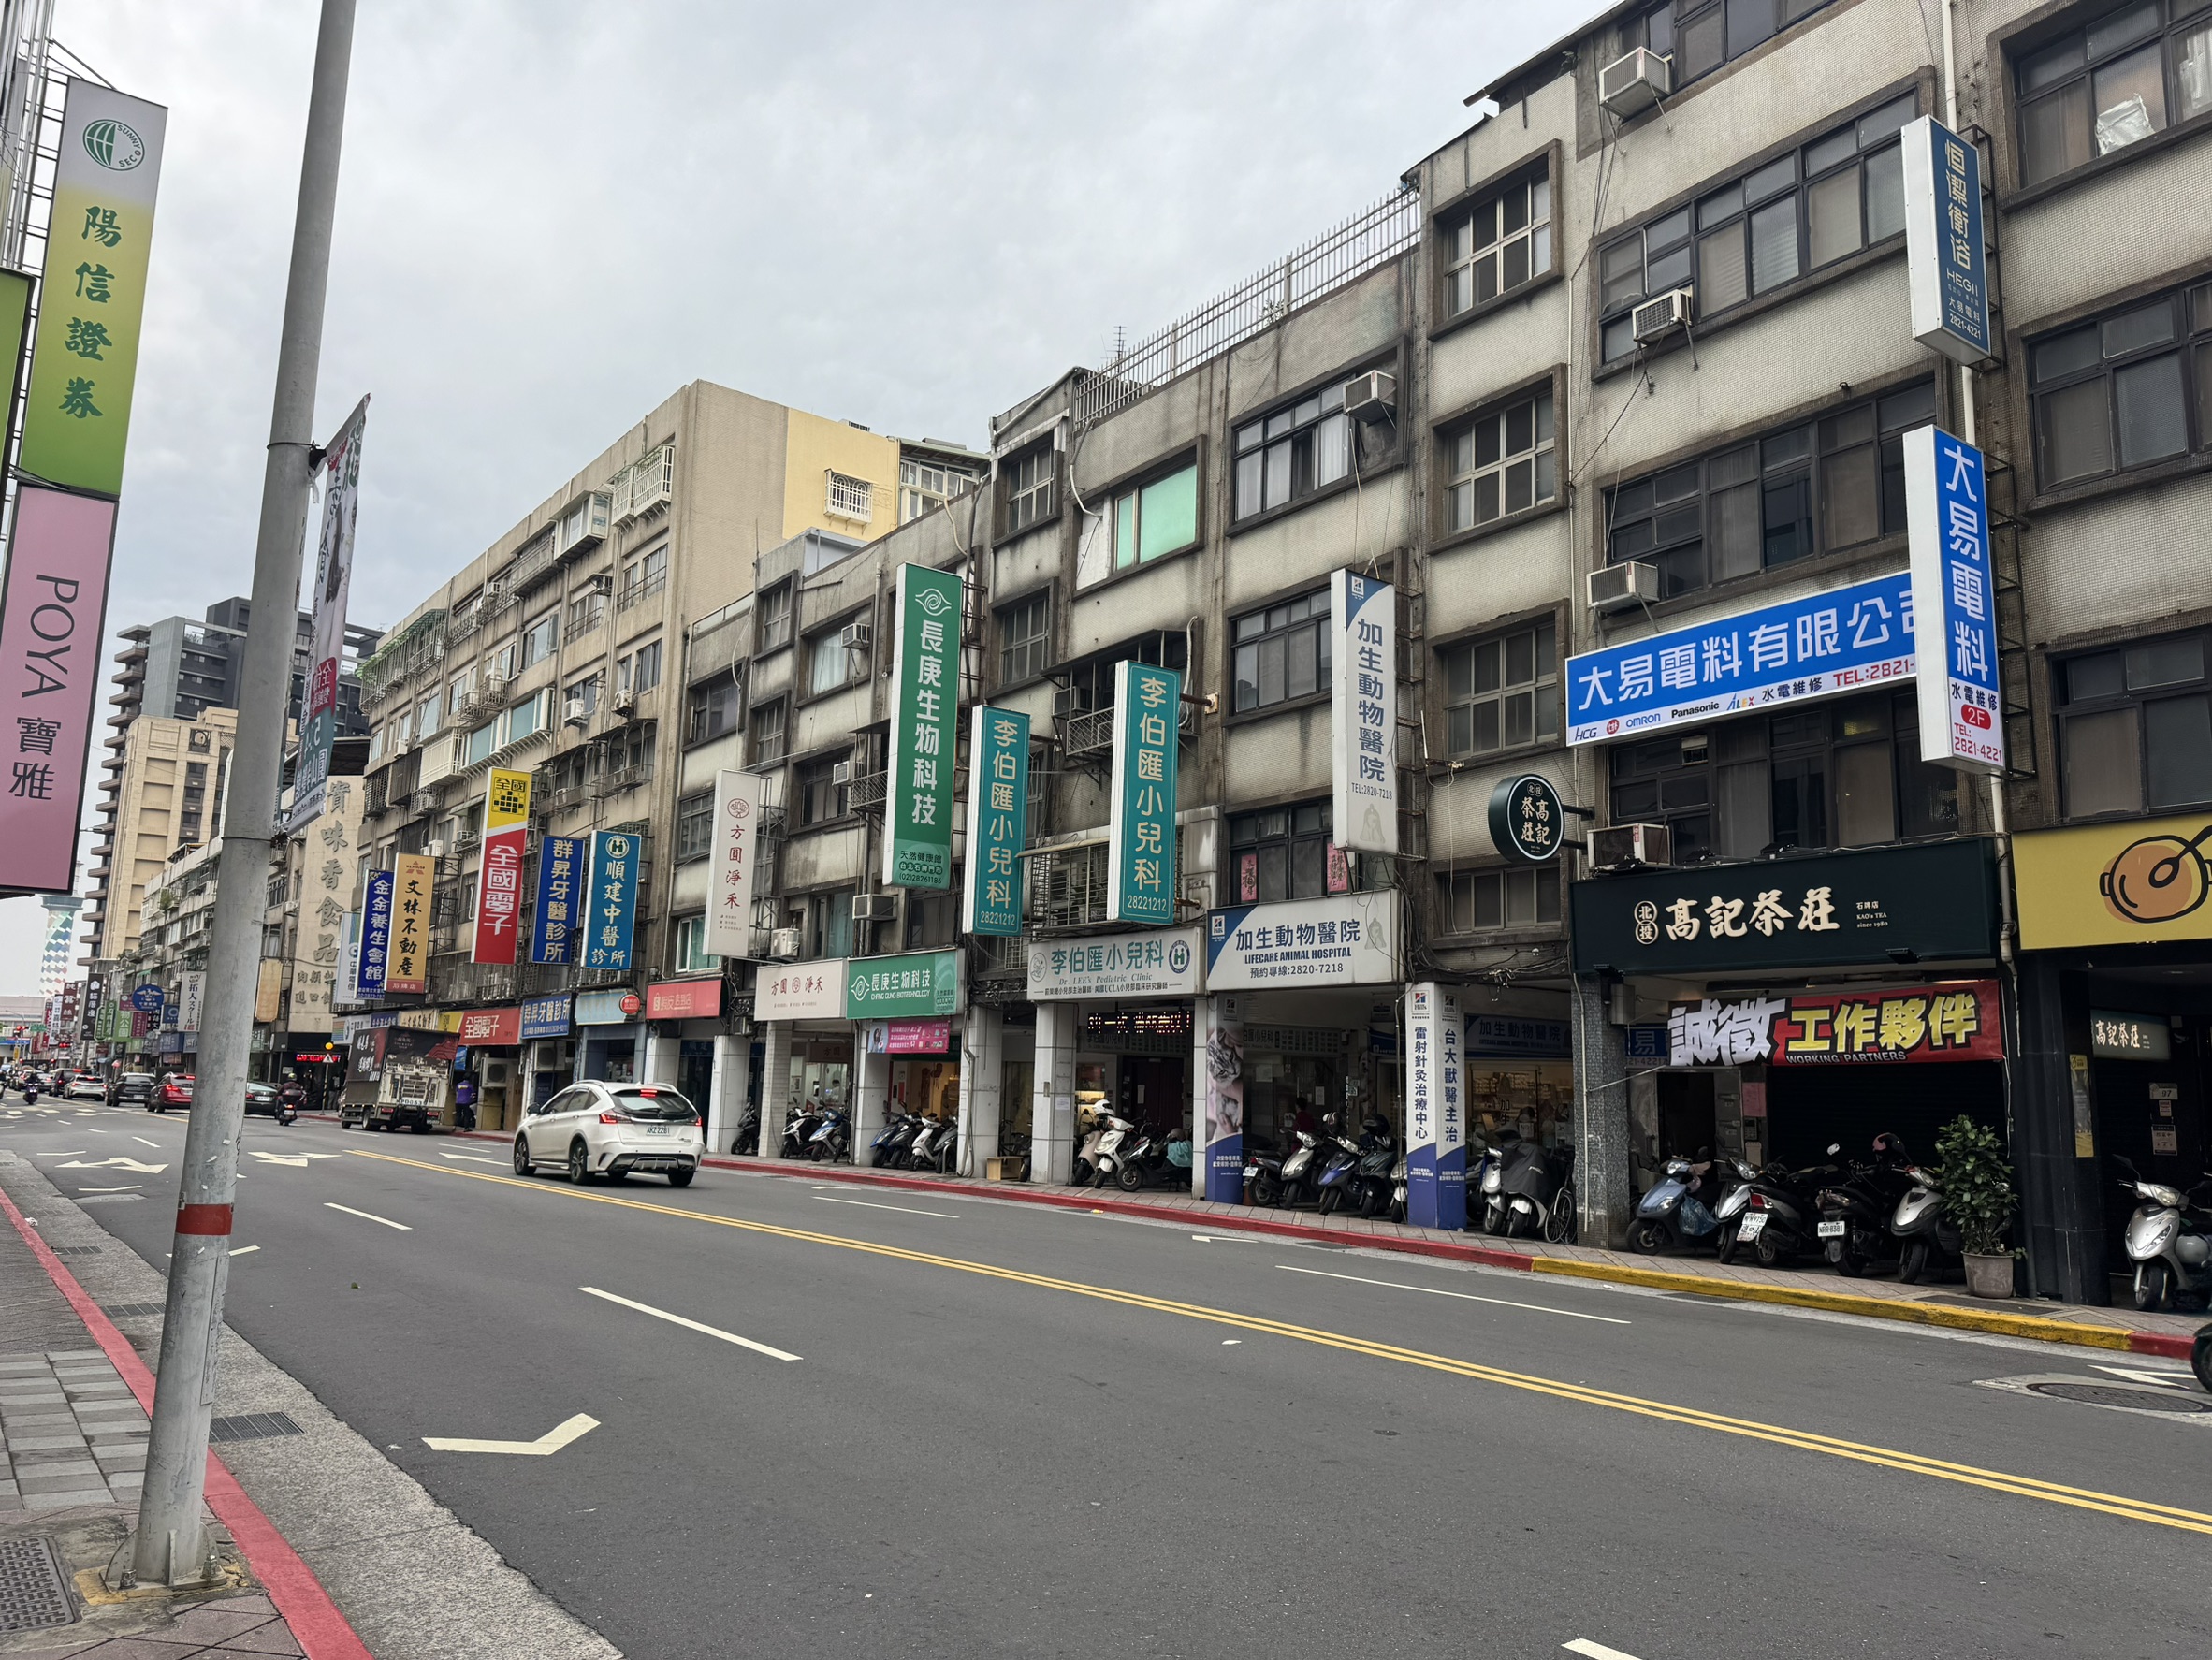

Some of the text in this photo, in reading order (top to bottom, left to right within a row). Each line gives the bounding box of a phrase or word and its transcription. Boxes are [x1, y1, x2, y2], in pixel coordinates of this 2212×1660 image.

[117, 124, 141, 149] SUNNY
[1946, 267, 1978, 298] HEGII
[58, 205, 123, 420] 陽信證券
[1948, 296, 1980, 324] 大易電料
[1949, 313, 1982, 340] 2821-4221
[1943, 444, 1988, 683] 大易電料
[8, 574, 80, 801] POYA 寶雅
[1358, 618, 1386, 783] 加生動物醫院
[1951, 681, 1999, 712] 水電維修
[911, 619, 944, 826] 長庚生物科技
[1574, 726, 1597, 743] HCG
[1625, 712, 1661, 729] OMRON
[1670, 701, 1720, 720] Panasonic
[1726, 693, 1755, 711] ALEX
[1761, 677, 1823, 703] 水電維修
[1967, 707, 1985, 726] 2F
[1954, 722, 1972, 739] TEL:
[1954, 737, 2003, 764] 2821-4221
[494, 778, 526, 793] 全國
[1134, 676, 1167, 893] 李伯匯小兒科
[1351, 782, 1393, 801] TEL:2820-7218
[985, 719, 1018, 909] 李伯匯小兒科
[723, 824, 746, 910] 方圓淨禾
[900, 850, 942, 864] 天然健康館
[483, 844, 518, 936] 全國電子
[899, 872, 942, 884] (02)28261186
[543, 839, 574, 962] 群昇牙醫診所
[601, 859, 627, 948] 順建中醫
[1128, 895, 1167, 912] 28221212
[1855, 901, 1880, 910] 石牌店
[365, 879, 392, 981] 金金養生會館
[396, 879, 424, 976] 文林不動產
[979, 910, 1016, 927] 28221212
[1637, 903, 1656, 942] 北投
[1235, 918, 1361, 952] 加生動物醫院
[591, 948, 626, 967] 診所
[1050, 939, 1165, 976] 李伯匯小兒科
[1244, 947, 1352, 965] LIFECARE ANIMAL HOSPITAL
[871, 968, 931, 992] 長庚生物科技
[1096, 973, 1127, 983] Pediatric
[1130, 972, 1153, 982] Clinic
[1249, 962, 1344, 980] 預約專線:2820-7218
[870, 992, 884, 1001] CHANG
[896, 989, 931, 999] BIOTECHNOLOGY
[524, 998, 571, 1024] 群昇牙醫診所
[464, 1014, 500, 1039] 全國電子
[1479, 1019, 1561, 1041] 加生動物醫院
[1785, 1049, 1907, 1065] WORKING PARTNERS
[1414, 1026, 1429, 1141] 雷射針灸治療中心
[1444, 1027, 1459, 1143] 台大獸醫主治
